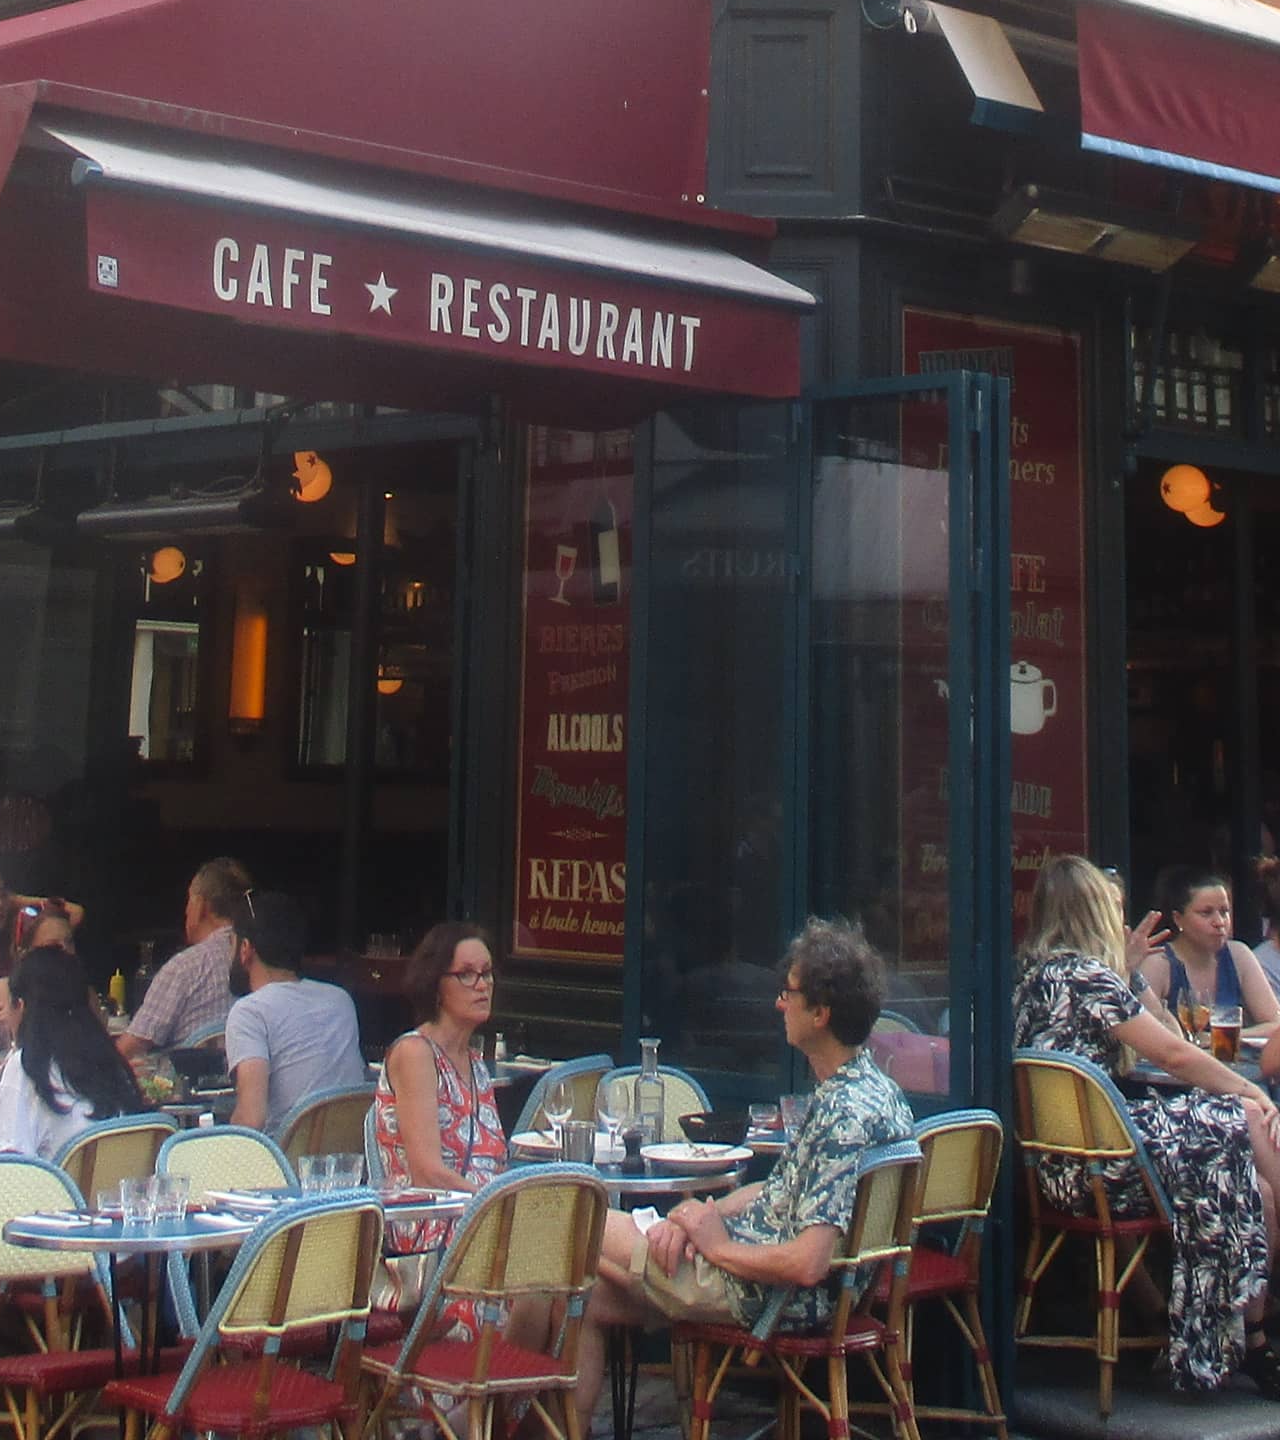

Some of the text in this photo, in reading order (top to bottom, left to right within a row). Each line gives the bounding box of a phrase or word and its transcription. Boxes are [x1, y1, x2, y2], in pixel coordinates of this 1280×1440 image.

[212, 237, 701, 371] CAFE RESTAURANT
[546, 713, 624, 753] ALCOOLS
[527, 858, 626, 904] REPAS
[581, 909, 625, 936] heure
